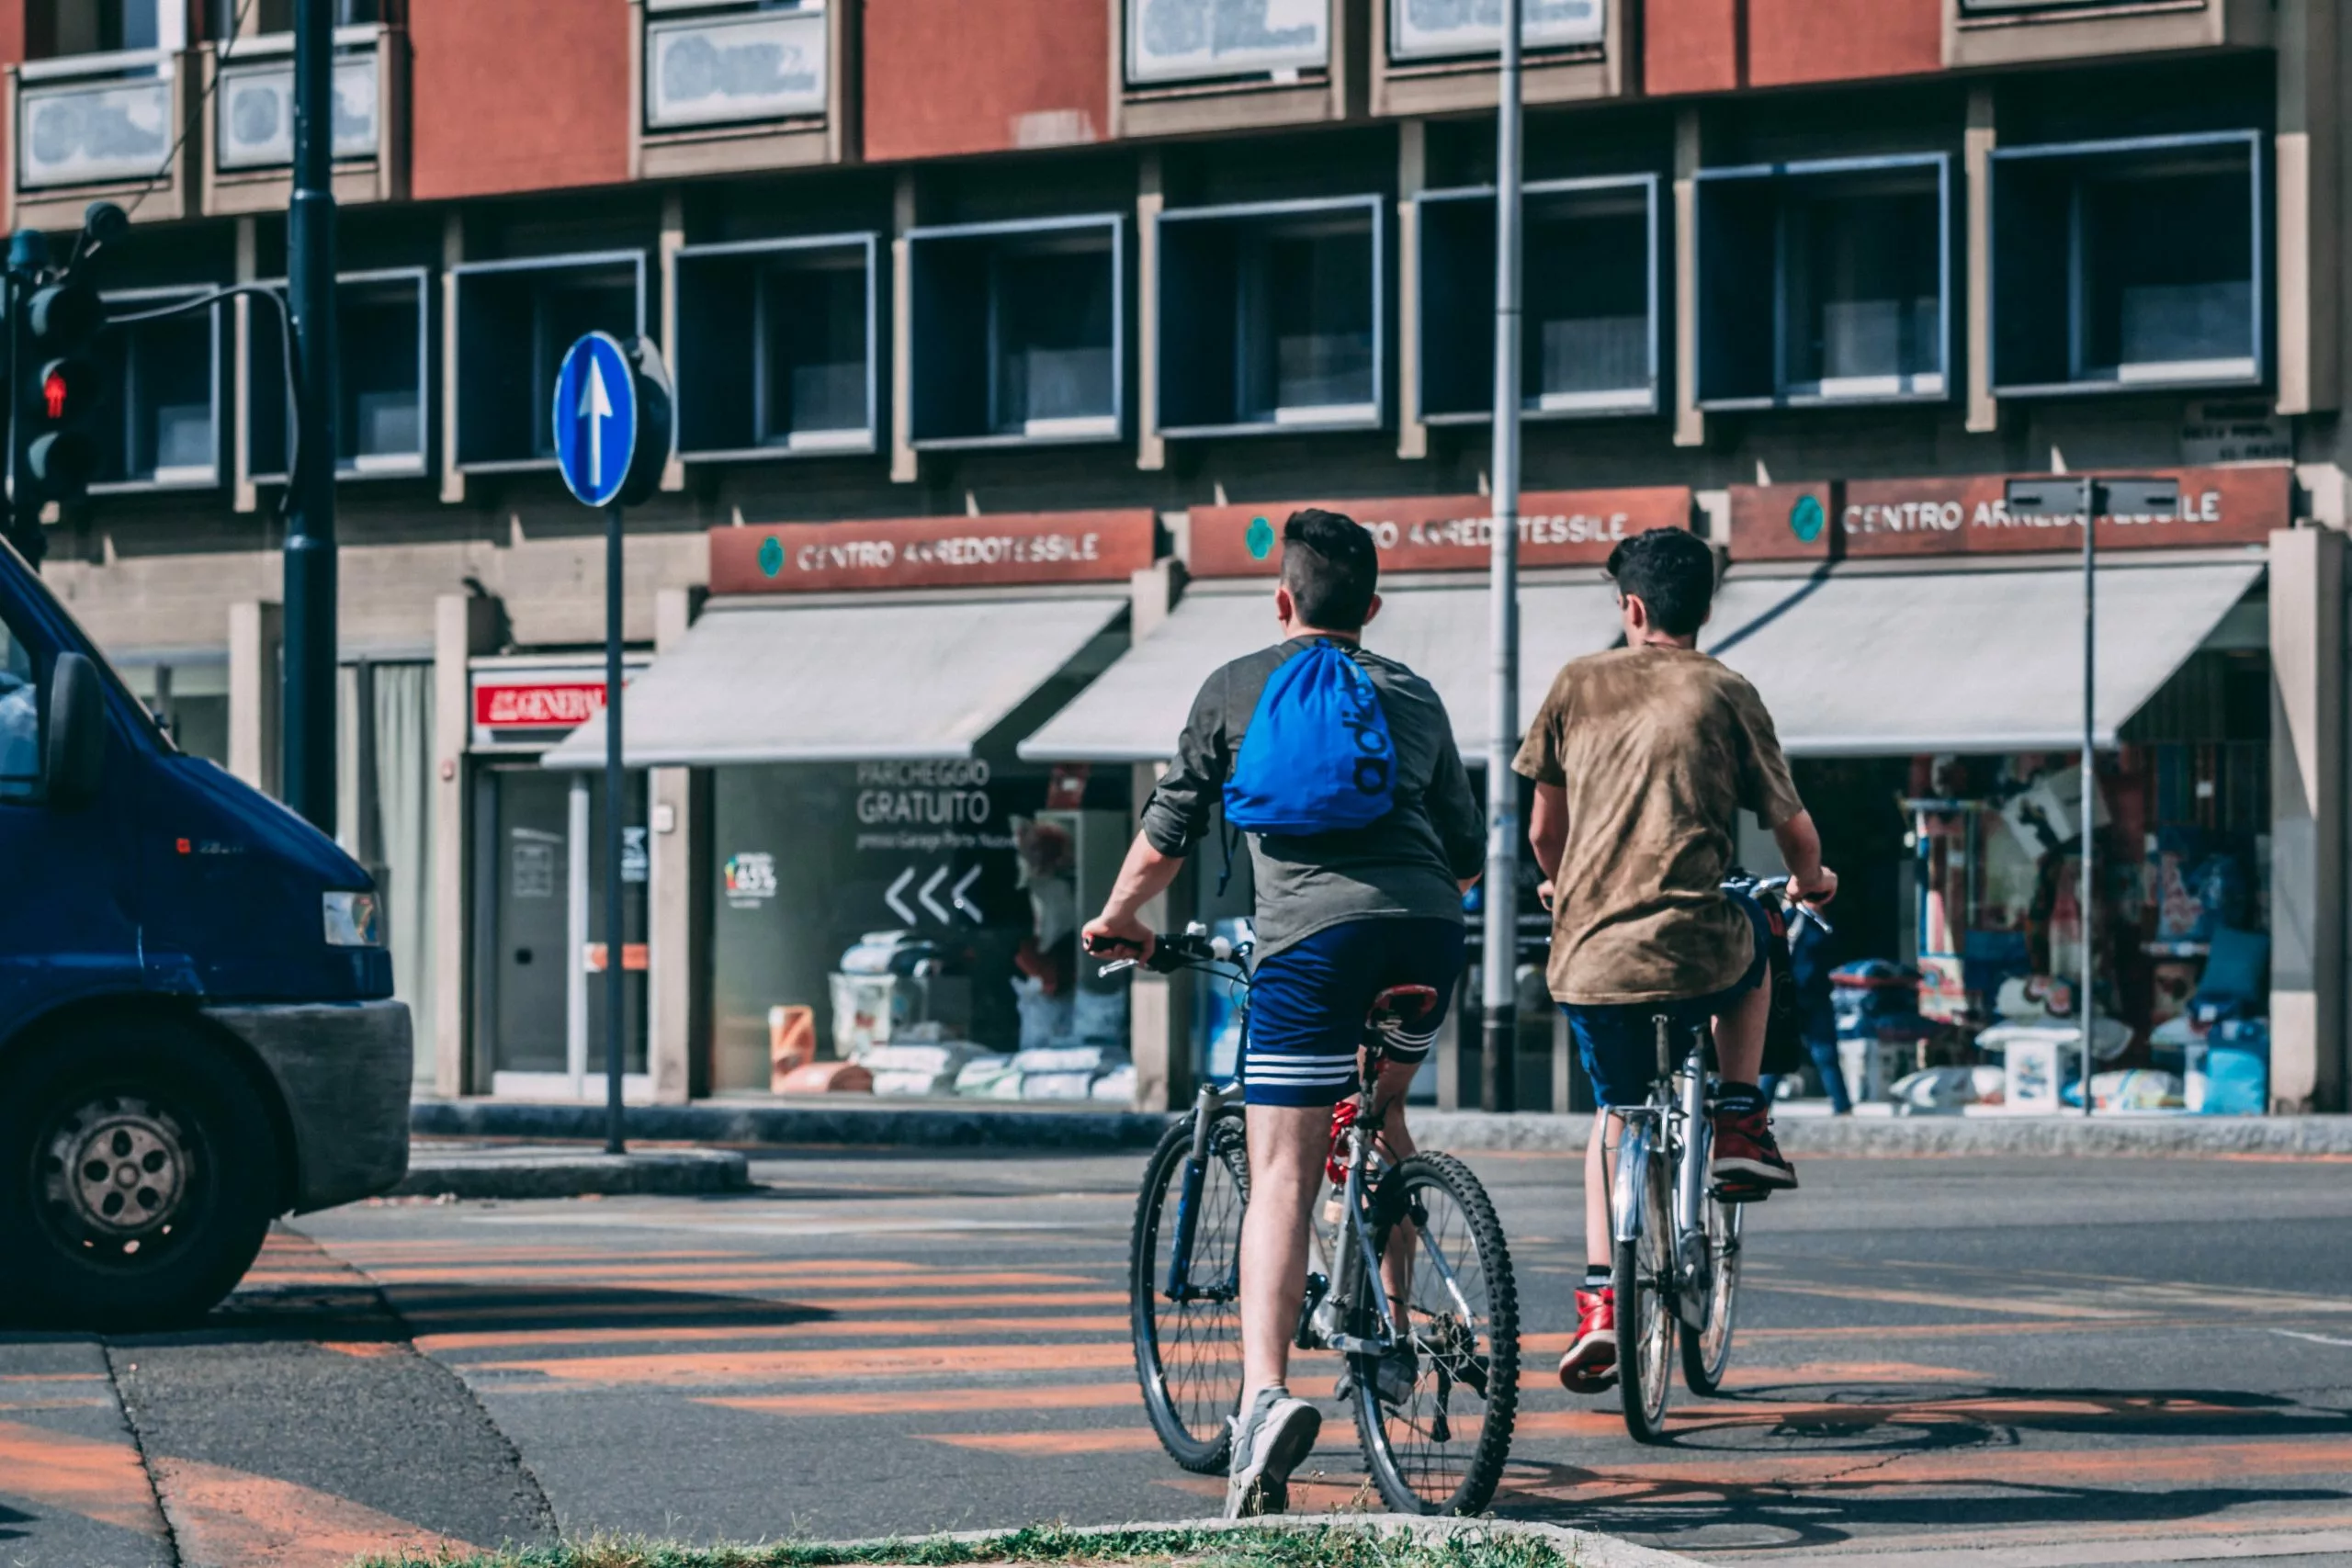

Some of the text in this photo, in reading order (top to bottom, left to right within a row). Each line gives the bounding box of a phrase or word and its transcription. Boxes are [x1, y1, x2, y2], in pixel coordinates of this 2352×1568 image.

[1407, 511, 1630, 548] ARREDTESSILE
[1842, 500, 1964, 535] CENTRO
[796, 539, 896, 571] CENTRO
[856, 790, 990, 824] GRATUITO
